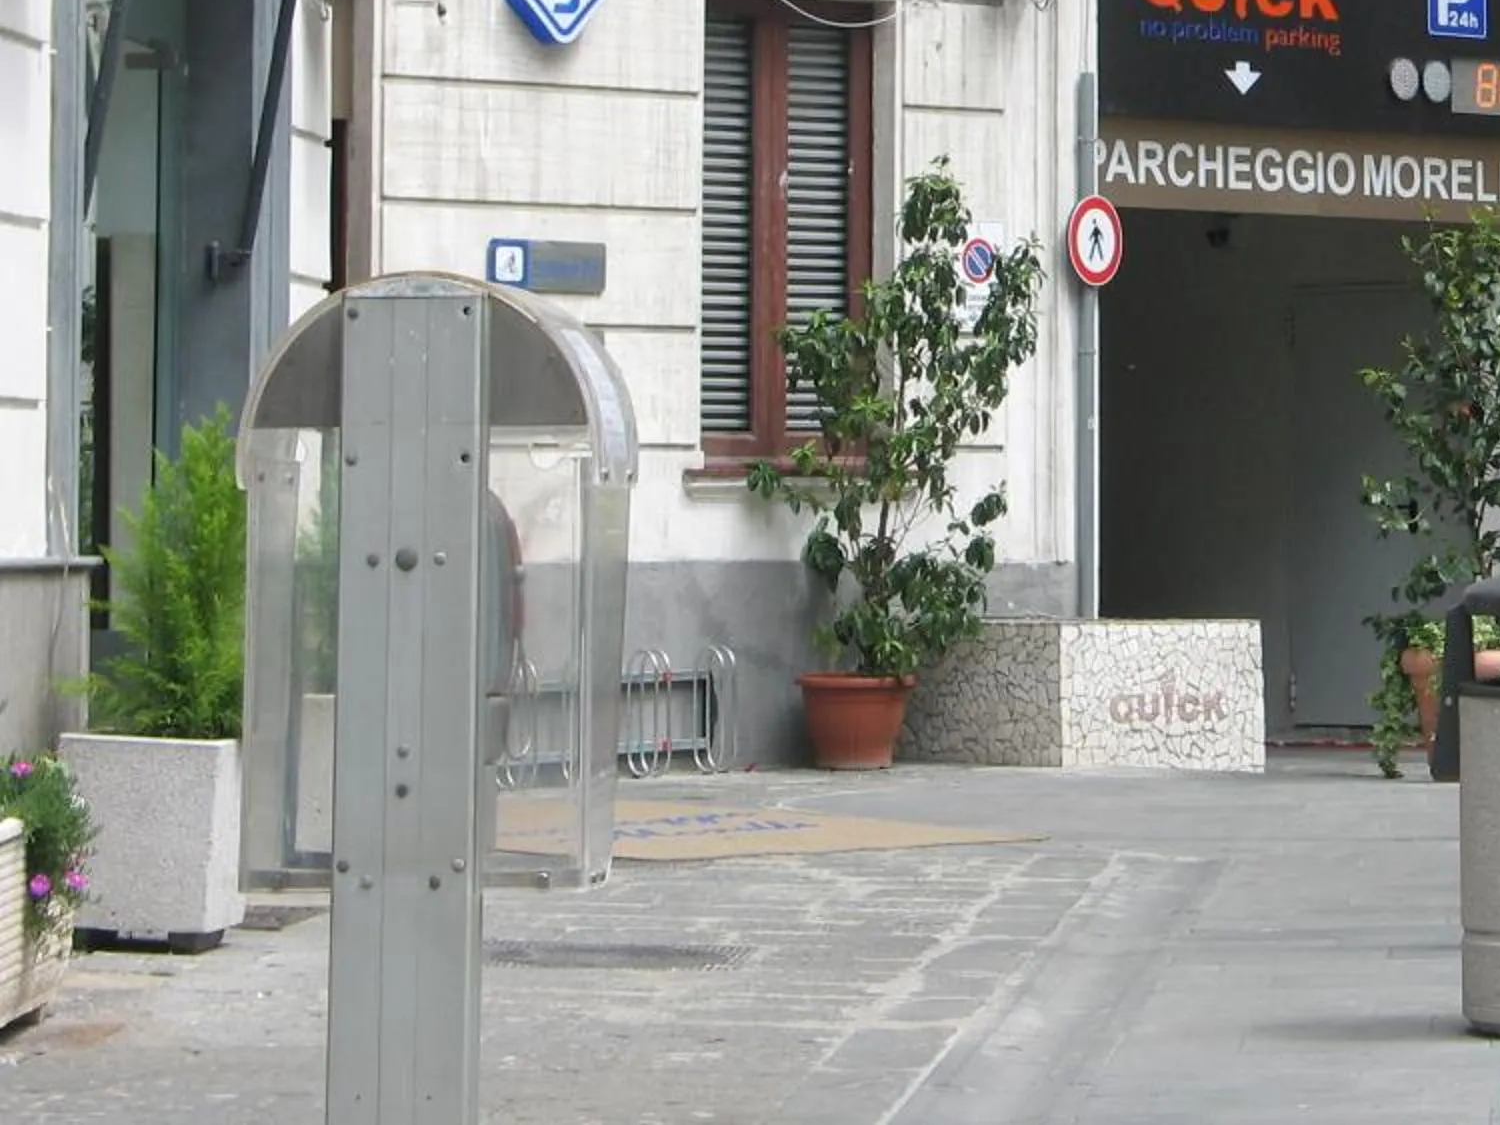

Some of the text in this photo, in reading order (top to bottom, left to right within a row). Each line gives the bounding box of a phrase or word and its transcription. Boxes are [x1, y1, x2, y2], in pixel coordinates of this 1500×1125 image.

[1140, 18, 1341, 56] no problem parking
[1449, 12, 1479, 28] 24h
[1094, 138, 1354, 195] PARCHEGGIO
